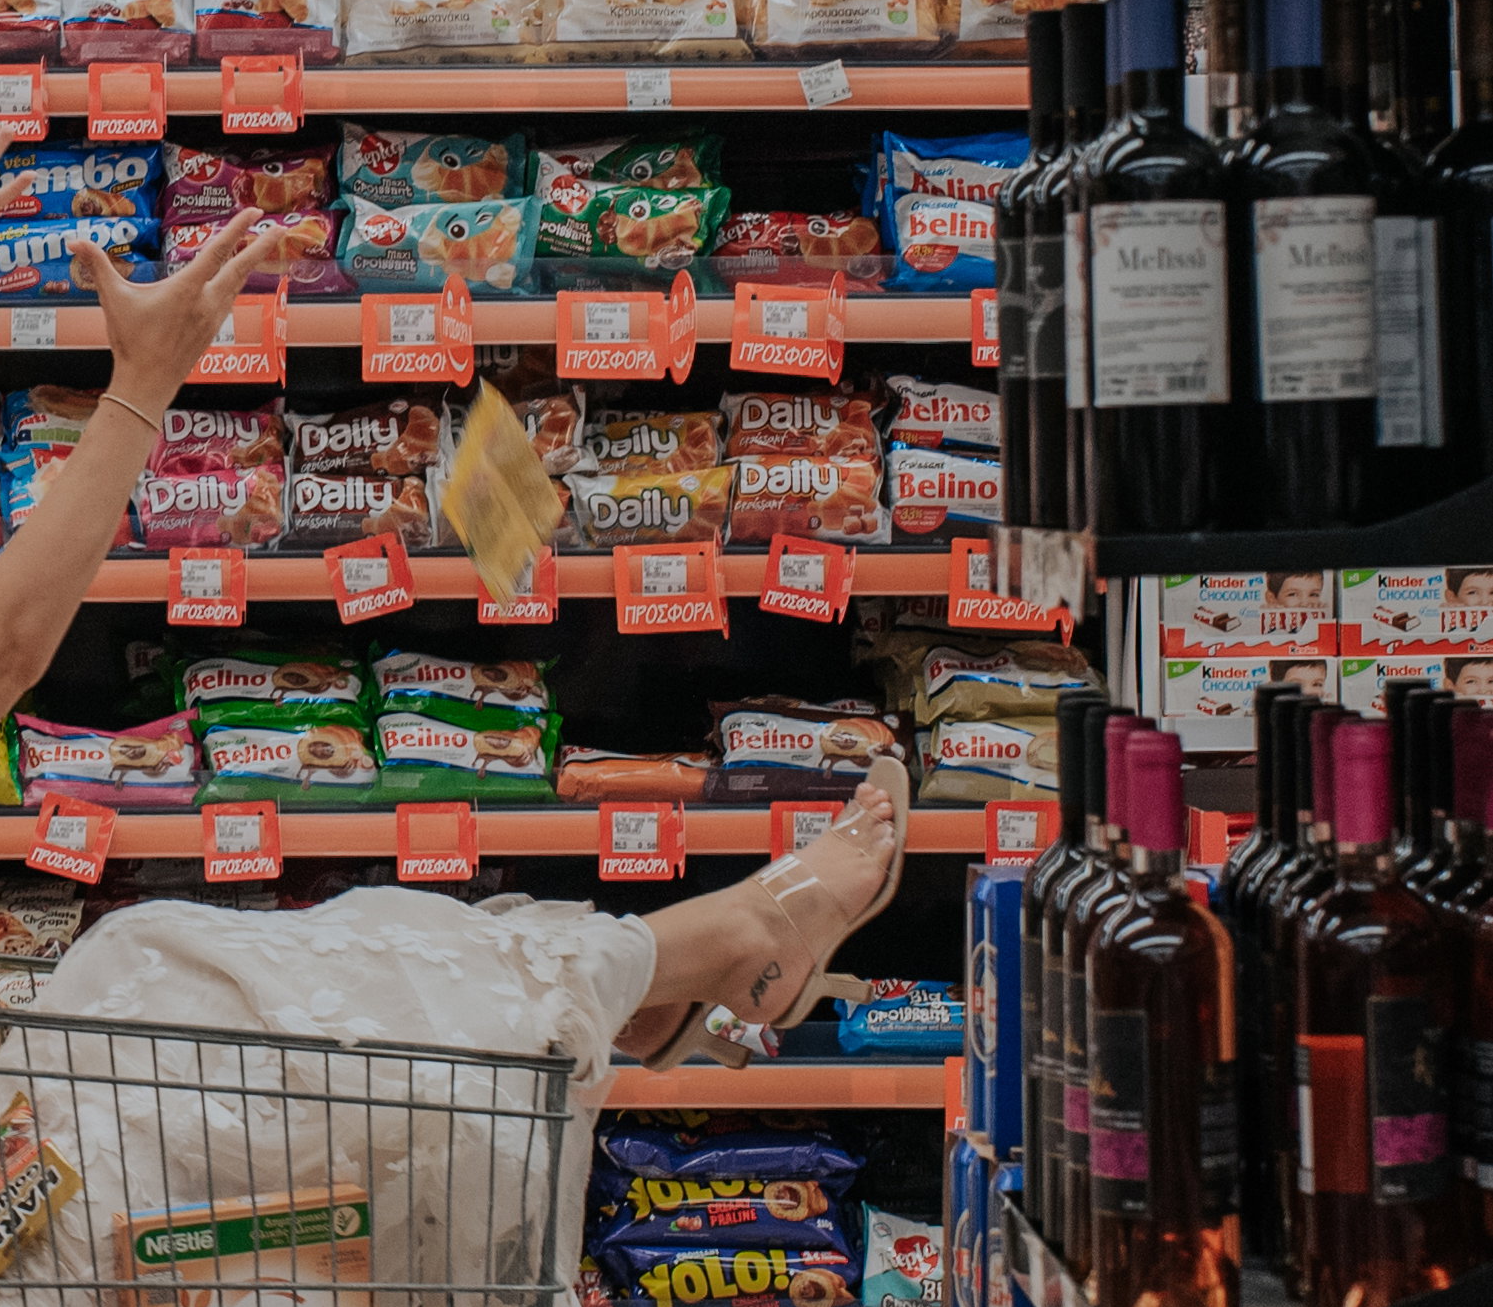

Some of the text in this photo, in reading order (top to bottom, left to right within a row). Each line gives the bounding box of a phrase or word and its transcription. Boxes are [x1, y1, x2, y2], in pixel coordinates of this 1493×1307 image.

[91, 118, 159, 135] ΠΡΟΣΦΟΡΑ
[226, 111, 294, 129] ΠΡΟΣΦΟΡΑ
[352, 179, 414, 197] Croissant
[172, 193, 233, 208] Croissant
[539, 220, 594, 245] roissant
[353, 255, 418, 273] Croissant
[386, 250, 412, 261] Maxi
[194, 353, 270, 374] ΟΣΦΟΡΑ
[369, 352, 446, 373] ΠΡΟΣΦΟ
[564, 349, 657, 370] ΠΡΟΣΦΟΡΑ
[741, 396, 842, 435] Daily
[897, 396, 992, 424] Belino
[163, 408, 261, 444] Daily
[301, 414, 401, 457] Daily
[586, 423, 679, 459] Daily
[738, 459, 841, 502] Daily
[898, 473, 999, 501] Belino
[147, 475, 249, 517] Daily
[294, 475, 395, 518] Daily
[588, 489, 692, 534] Daily
[1199, 574, 1246, 590] Kinder
[1377, 574, 1425, 589] Kinder
[342, 586, 409, 618] ΠΡΟΣΦΟΡΑ
[763, 589, 831, 616] ΠΡΟΣΦΟΡΑ
[1199, 588, 1262, 602] CHOCOLATE
[1377, 587, 1441, 602] CHOCOLATE
[170, 603, 239, 622] ΠΡΟΣΦΟΡΑ
[482, 602, 550, 619] ΠΡΣΦΟΡΑ
[624, 601, 716, 626] ΠΡΟΣΦΟΡΑ
[956, 596, 1049, 622] ΠΡΟΣΦΟΡΑ
[187, 669, 268, 694] Belino
[382, 664, 467, 688] Belino
[1202, 665, 1248, 680] Kinder
[1376, 663, 1423, 678] Kinder
[383, 727, 469, 751] Belino
[727, 728, 815, 752] Belino
[939, 735, 1022, 760] Belino
[28, 744, 106, 771] Belino
[212, 740, 293, 772] Belino
[31, 846, 98, 878] ΠΡΟΣΦΟΡΑ
[209, 855, 277, 876] ΠΡΟΣΦΟΡΑ
[401, 856, 469, 876] ΠΡΟΣΦΟΡΑ
[603, 857, 670, 876] ΠΡΟΣΦΟΡΑ
[909, 989, 942, 1008] Big
[867, 1005, 951, 1025] Croissant
[709, 1207, 757, 1227] PRALINE
